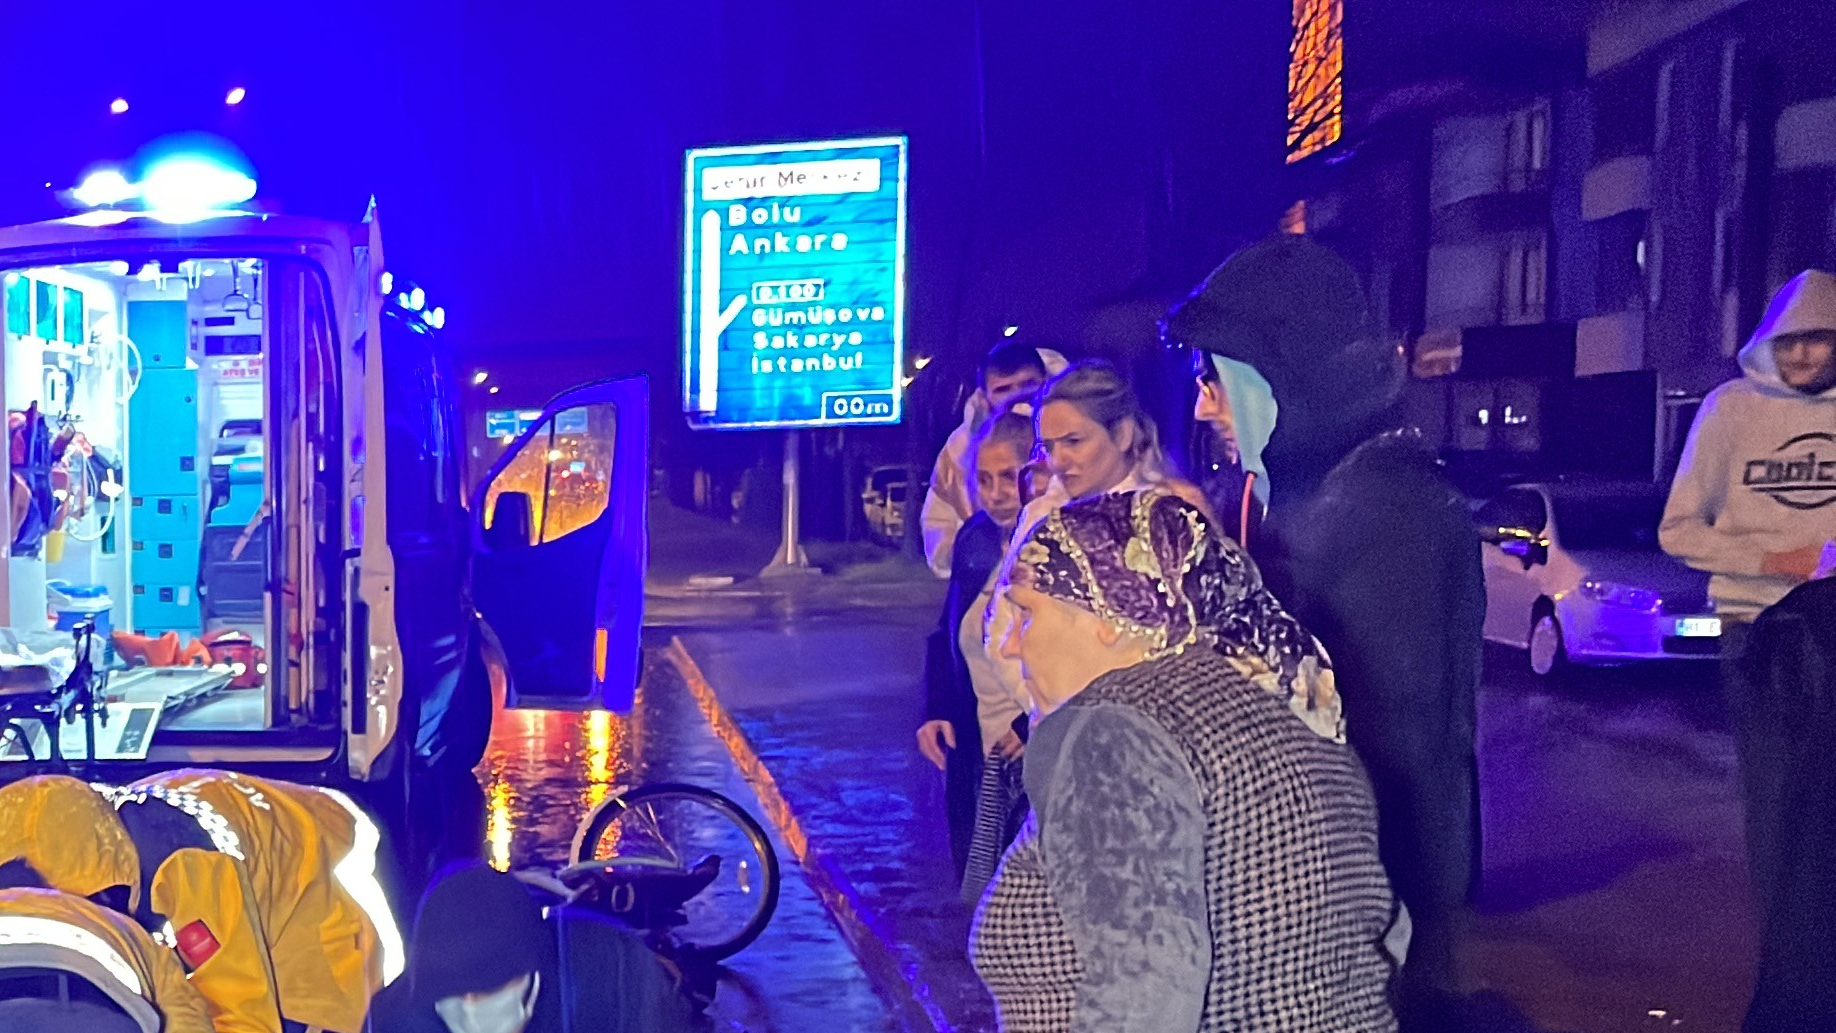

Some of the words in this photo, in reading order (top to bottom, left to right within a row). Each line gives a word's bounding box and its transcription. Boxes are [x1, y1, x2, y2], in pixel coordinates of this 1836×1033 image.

[728, 202, 801, 226] Bolu
[728, 231, 849, 255] Ankara
[752, 330, 863, 351] Sakarya
